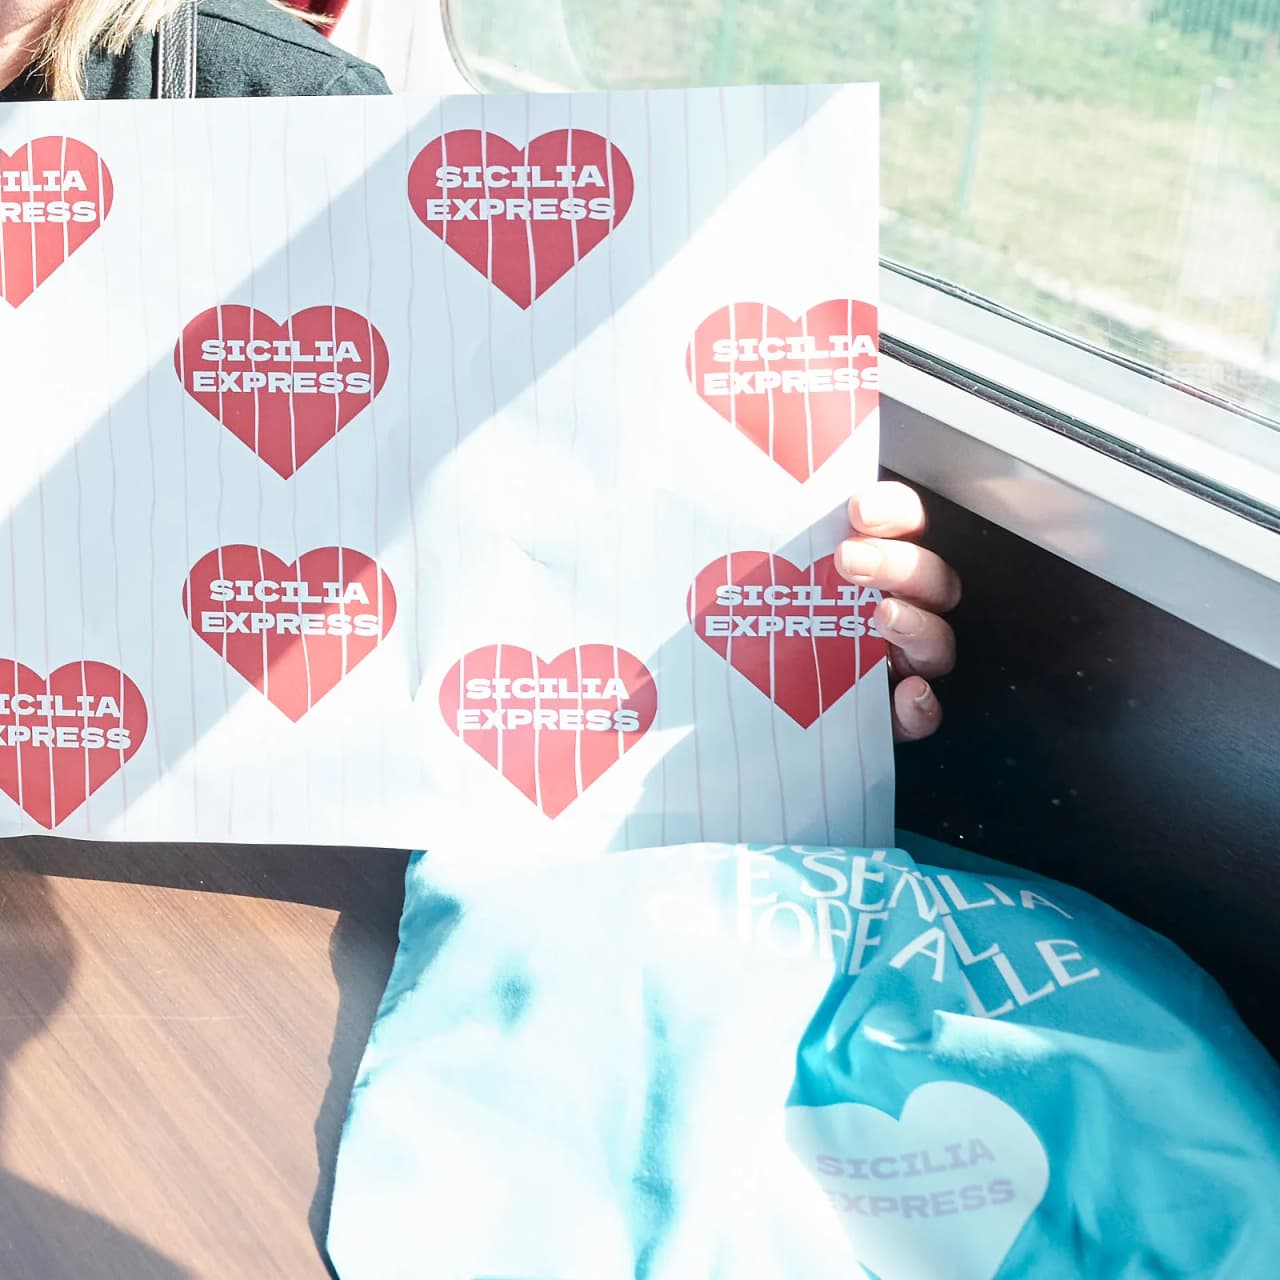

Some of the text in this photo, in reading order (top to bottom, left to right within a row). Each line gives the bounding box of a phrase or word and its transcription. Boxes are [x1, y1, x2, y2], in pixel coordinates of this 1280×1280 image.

[435, 164, 606, 188] SICILIA
[426, 197, 615, 221] EXPRESS
[201, 339, 363, 363] SICILIA
[712, 334, 879, 363] SICILIA
[192, 371, 371, 395] EXPRESS
[209, 579, 370, 605] SICILIA
[715, 585, 884, 606] SICILIA
[201, 611, 379, 637] EXPRESS
[466, 677, 630, 700] SICILIA
[456, 709, 640, 733] EXPRESS
[815, 1137, 997, 1180] SICILIA
